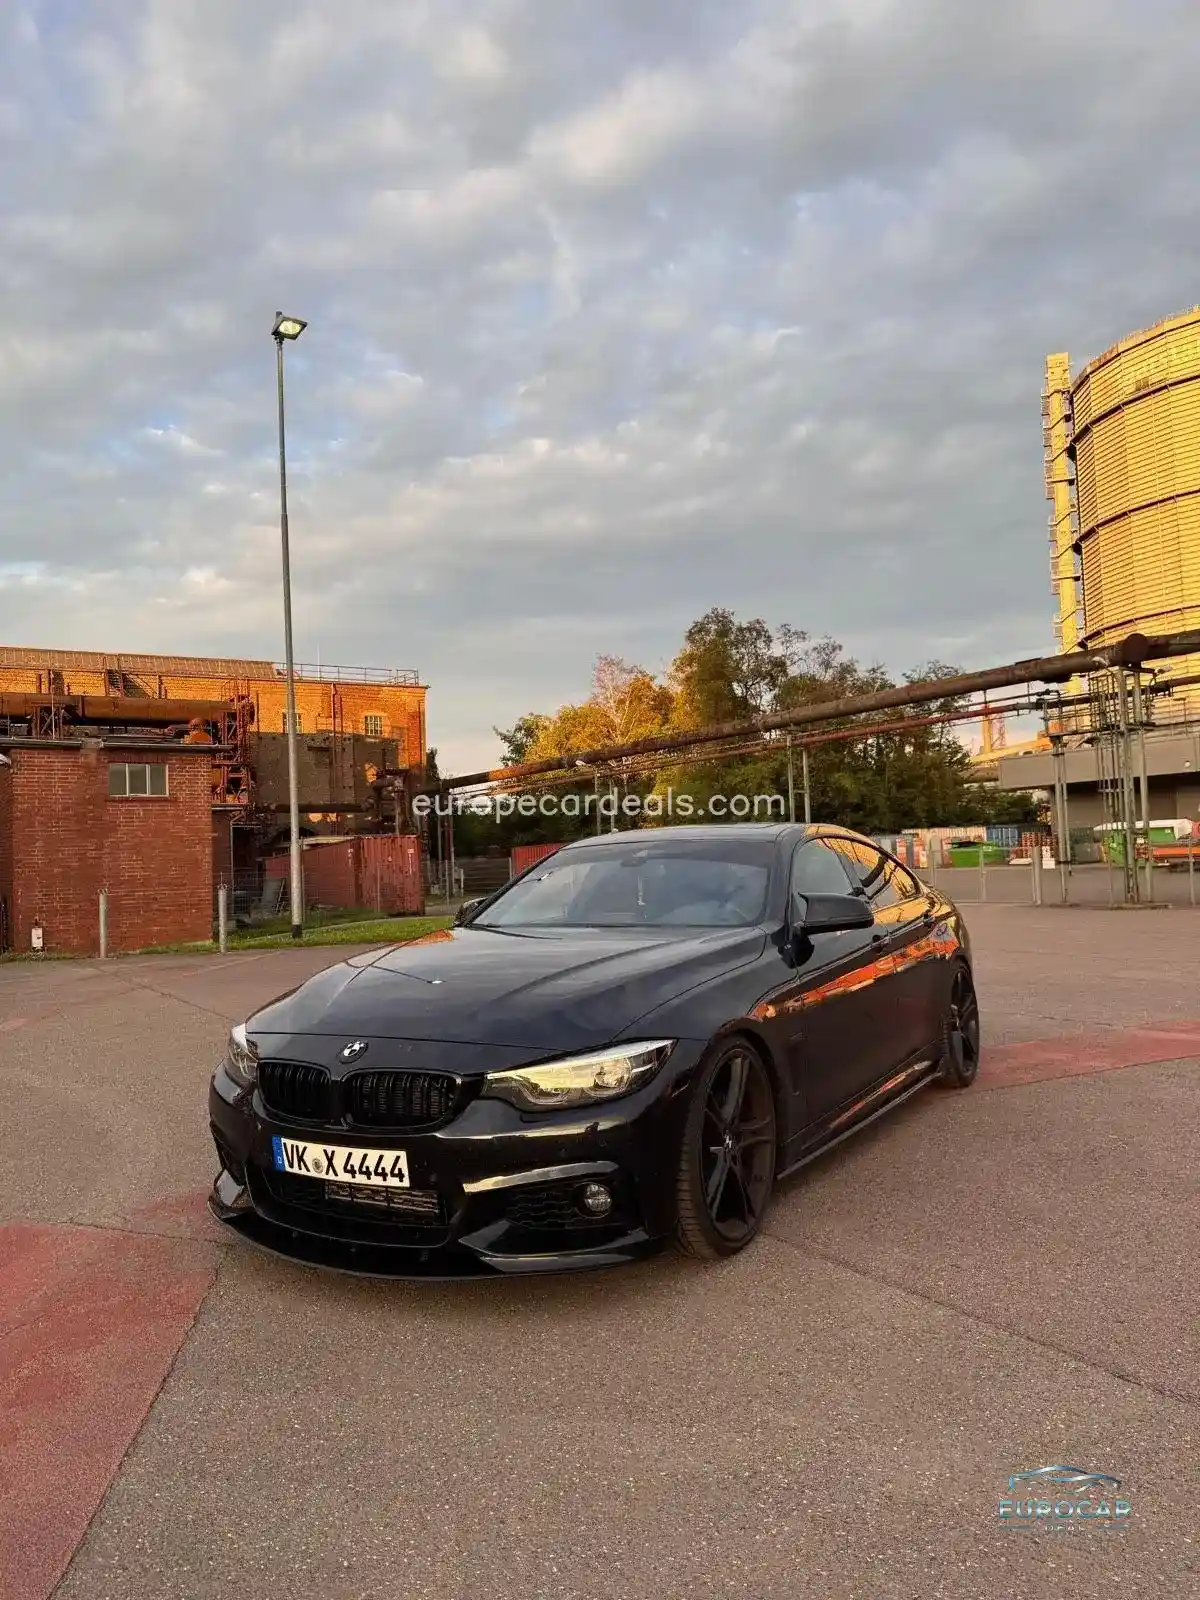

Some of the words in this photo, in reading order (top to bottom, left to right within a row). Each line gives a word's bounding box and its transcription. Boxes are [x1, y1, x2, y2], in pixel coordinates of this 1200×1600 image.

[283, 1142, 310, 1172] VK
[323, 1148, 338, 1177] X
[343, 1151, 405, 1182] 4444
